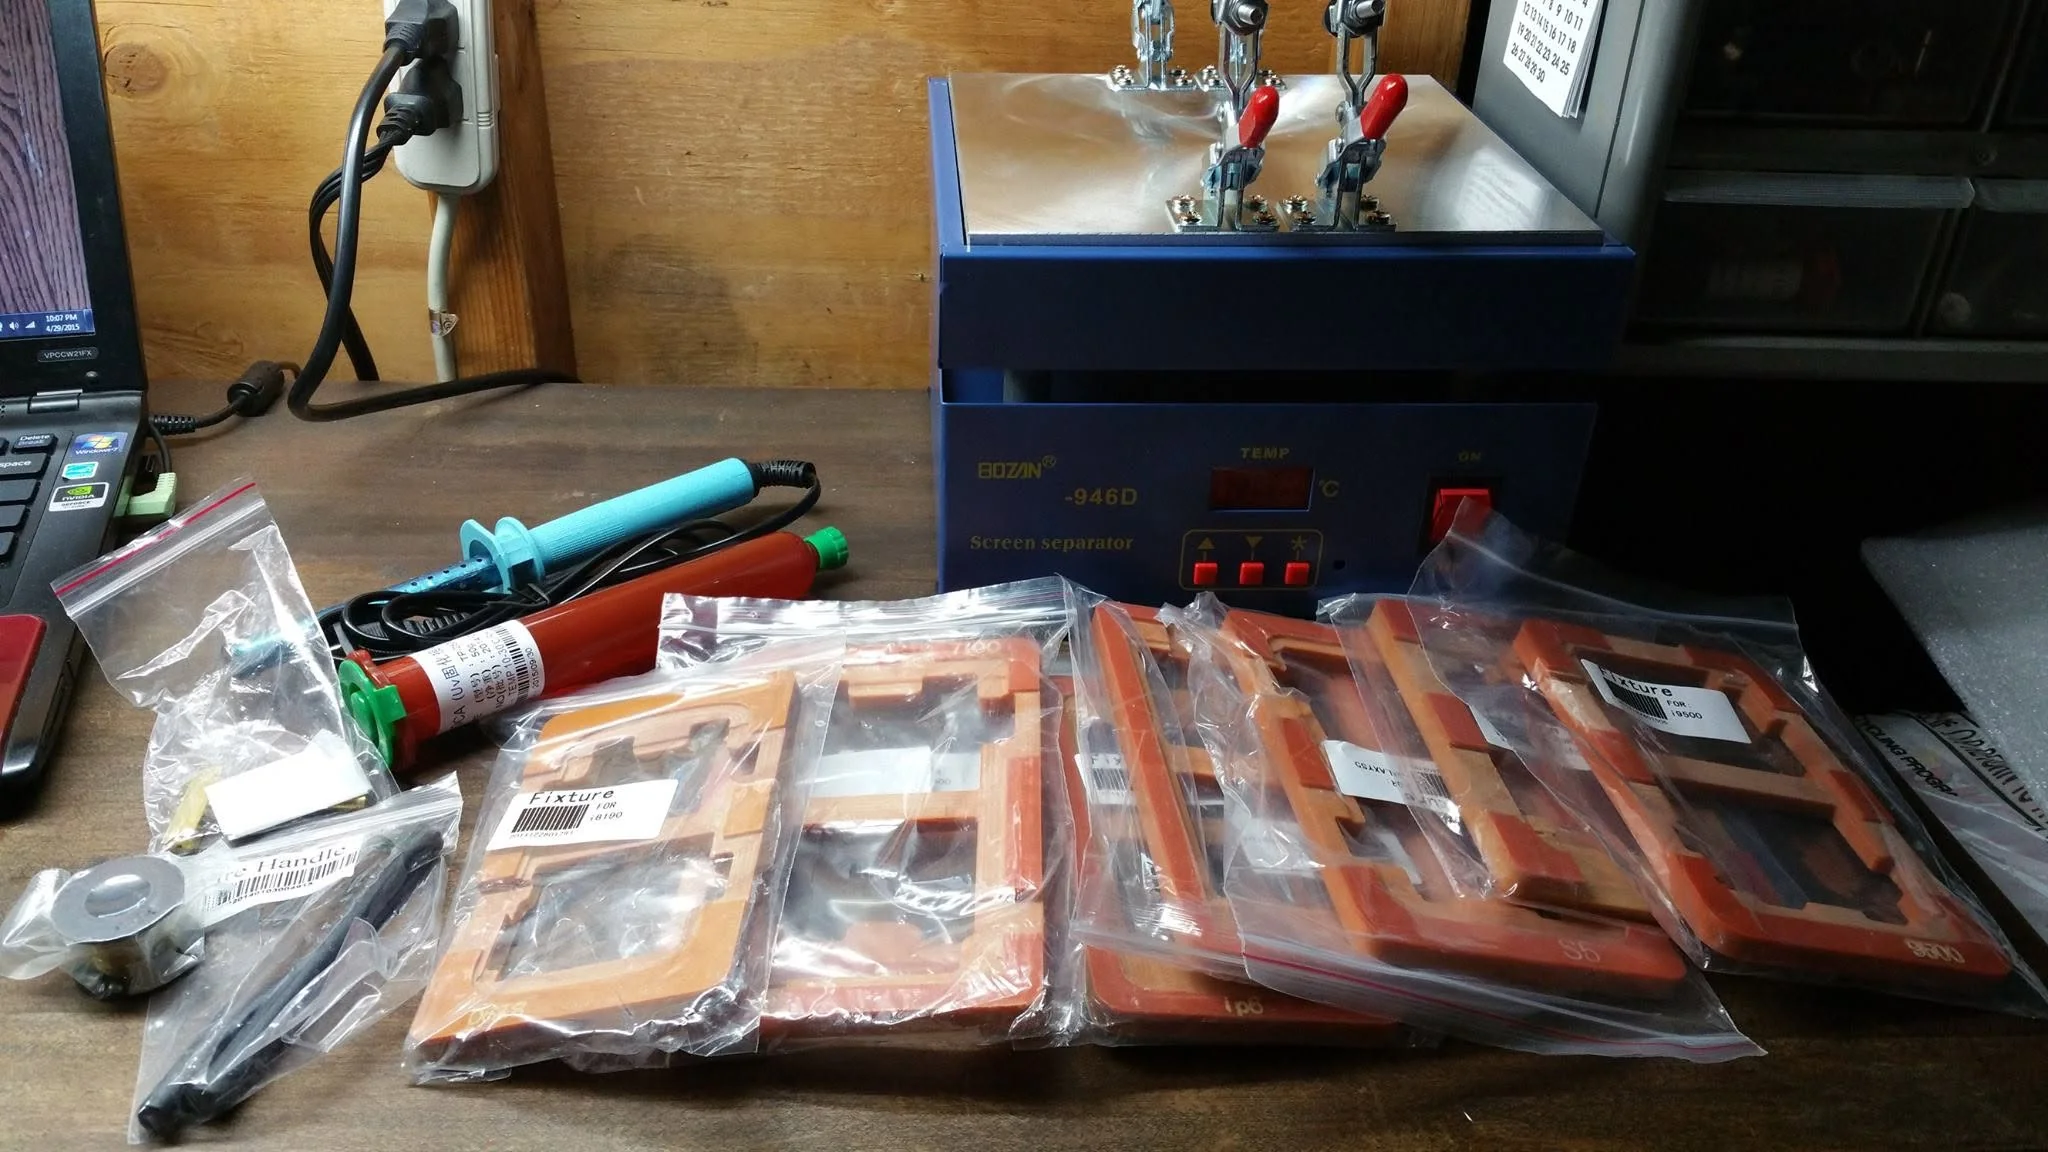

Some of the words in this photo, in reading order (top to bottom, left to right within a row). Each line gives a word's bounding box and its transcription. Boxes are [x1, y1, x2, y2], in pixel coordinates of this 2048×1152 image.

[1523, 1, 1530, 16] 12
[1530, 7, 1537, 22] 13
[1536, 12, 1544, 27] 14
[1542, 18, 1549, 33] 15
[1549, 24, 1557, 40] 16
[1558, 31, 1566, 46] 17
[1567, 37, 1576, 54] 18
[1556, 4, 1562, 16] 9
[1564, 9, 1574, 24] 10
[1574, 16, 1583, 31] 11
[1517, 22, 1524, 36] 19
[1524, 28, 1532, 42] 20
[1536, 40, 1544, 55] 22
[1542, 46, 1551, 62] 23
[1551, 53, 1560, 69] 24
[1560, 60, 1570, 76] 25
[1511, 42, 1518, 56] 26
[1530, 61, 1538, 76] 29
[1536, 68, 1546, 82] 30
[46, 324, 80, 332] 4/29/2015
[1240, 448, 1290, 460] TEMP
[1458, 450, 1482, 462] ON
[970, 535, 1036, 550] Screen
[1041, 536, 1134, 552] separator
[1600, 666, 1673, 698] Fixture
[529, 789, 614, 804] Fixture
[596, 802, 617, 810] FOR
[257, 846, 346, 872] Handle
